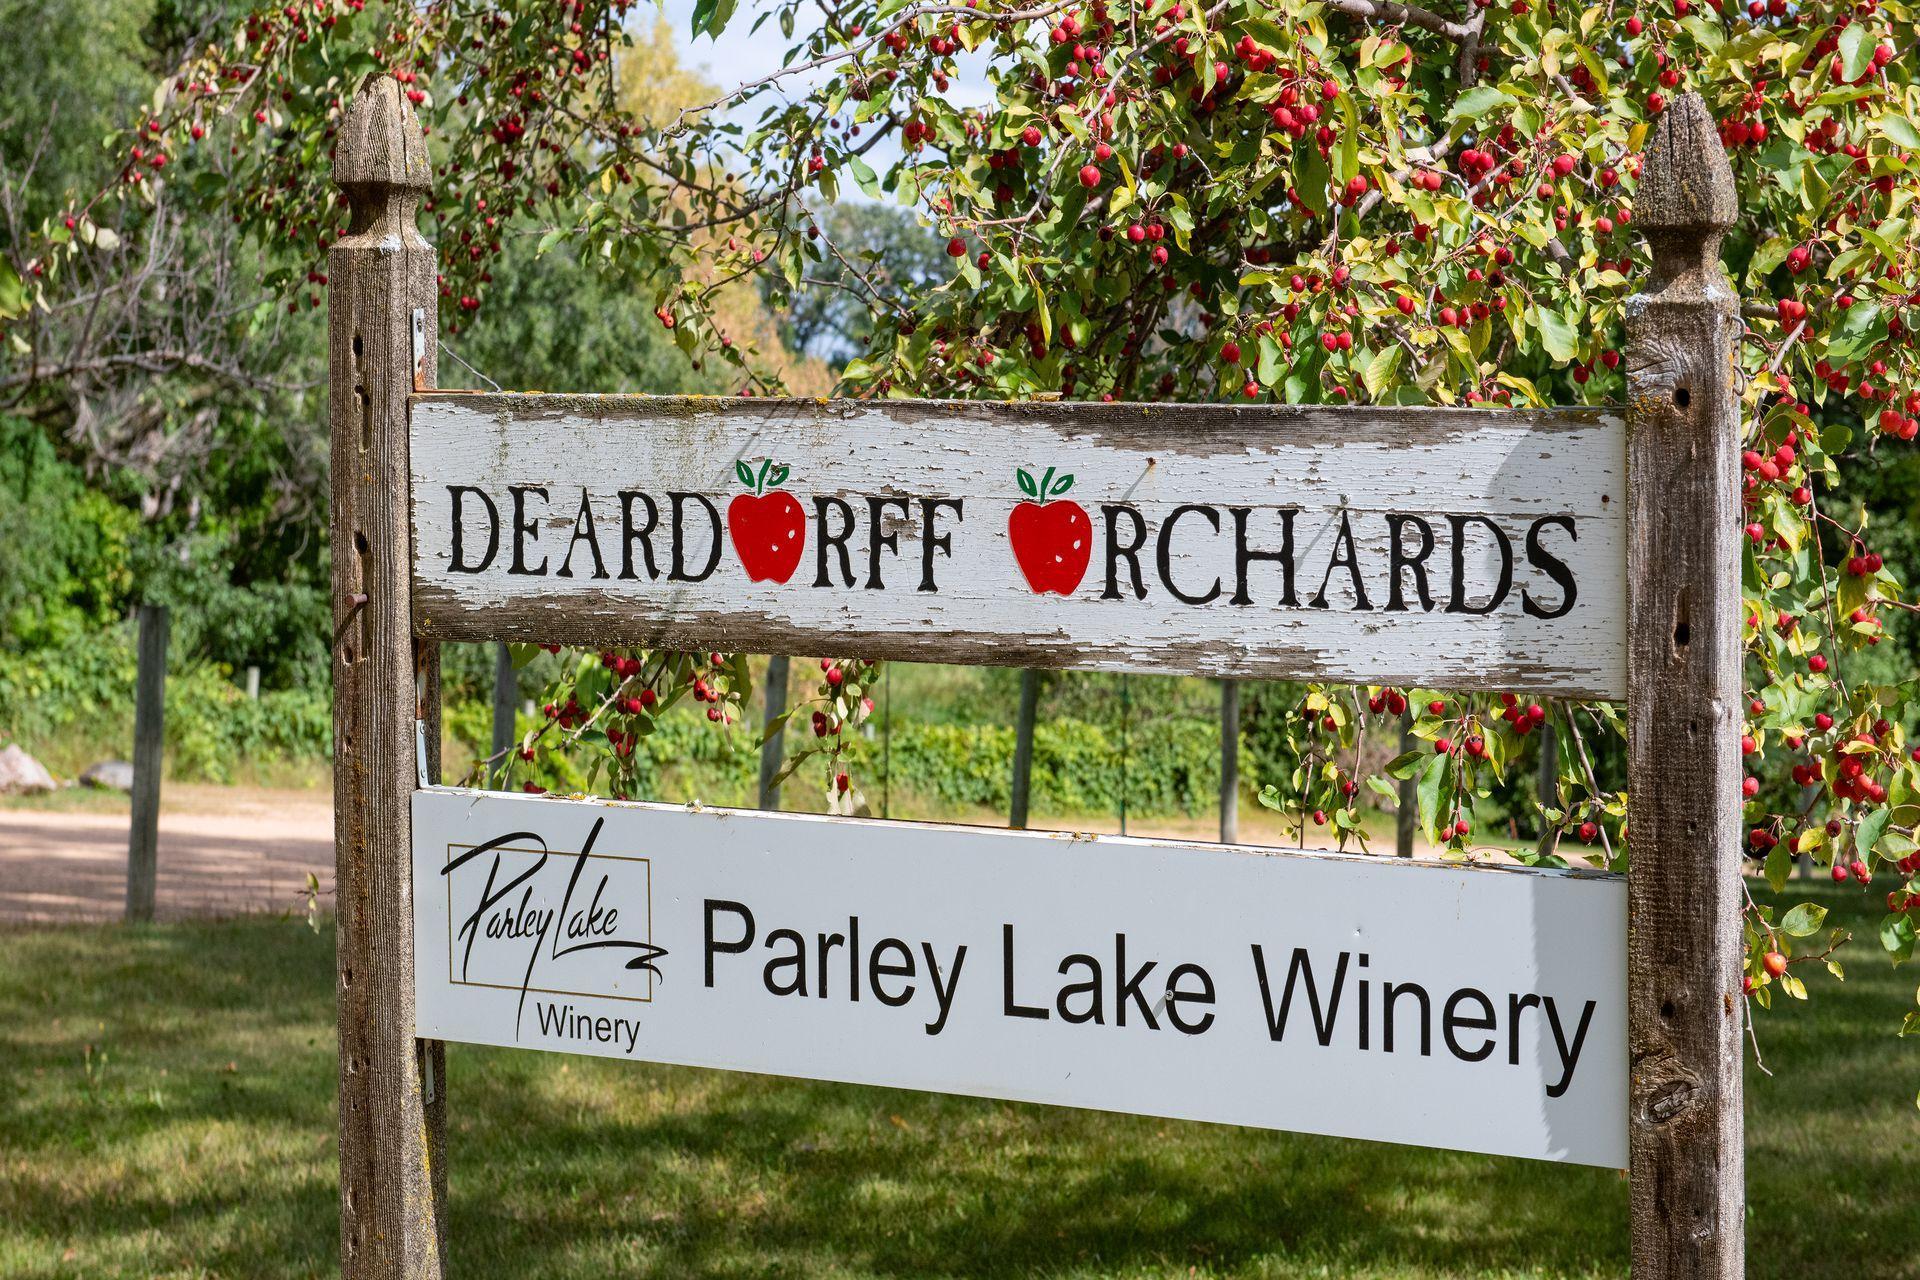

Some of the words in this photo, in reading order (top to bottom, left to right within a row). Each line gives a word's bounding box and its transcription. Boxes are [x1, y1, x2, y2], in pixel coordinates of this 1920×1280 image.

[441, 831, 554, 1042] Parley
[552, 816, 669, 985] Lake
[537, 1002, 641, 1053] Winery
[703, 899, 968, 1036] Parley
[1003, 923, 1216, 1035] Lake
[1251, 944, 1597, 1098] Winery
